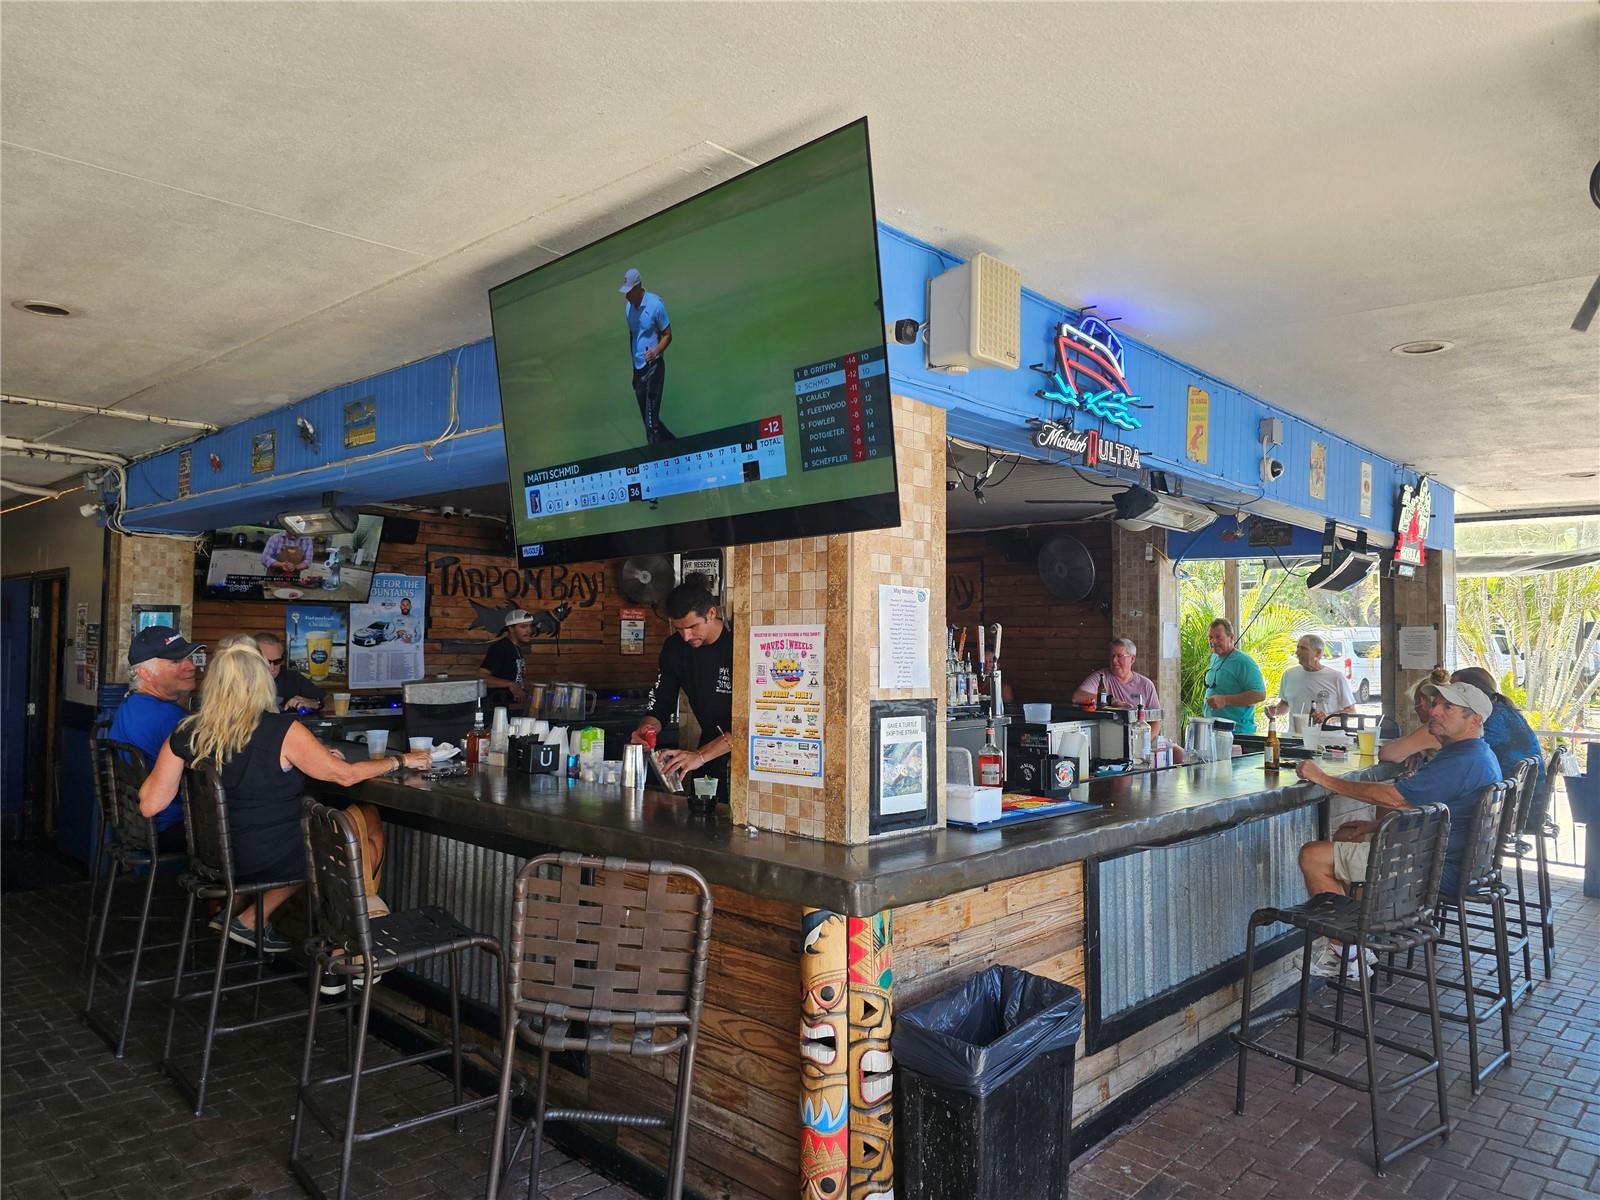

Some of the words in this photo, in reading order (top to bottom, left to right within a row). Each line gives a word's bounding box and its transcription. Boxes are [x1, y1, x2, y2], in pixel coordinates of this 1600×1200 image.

[810, 362, 837, 374] GRIFFIN
[805, 379, 830, 390] SCHMID
[806, 391, 831, 402] CAULEY
[807, 401, 846, 415] FLEETWOOD
[808, 416, 835, 428] FOWLER
[810, 428, 845, 441] POTGIETER
[760, 438, 780, 447] TOTAL
[1038, 424, 1088, 454] Michelob
[1098, 439, 1140, 469] ULTRA
[527, 471, 548, 484] MATTI
[549, 465, 580, 479] SCHMID
[764, 421, 779, 433] -12
[810, 446, 827, 454] HALL
[811, 454, 848, 467] SCHEFFLER
[631, 488, 639, 496] 36
[434, 556, 544, 599] TARPON
[383, 580, 400, 588] FOR
[404, 580, 420, 589] THE
[371, 588, 415, 598] OUNTAINS
[760, 640, 785, 650] WAVES
[789, 640, 813, 650] WHEELS
[540, 747, 552, 766] Ü
